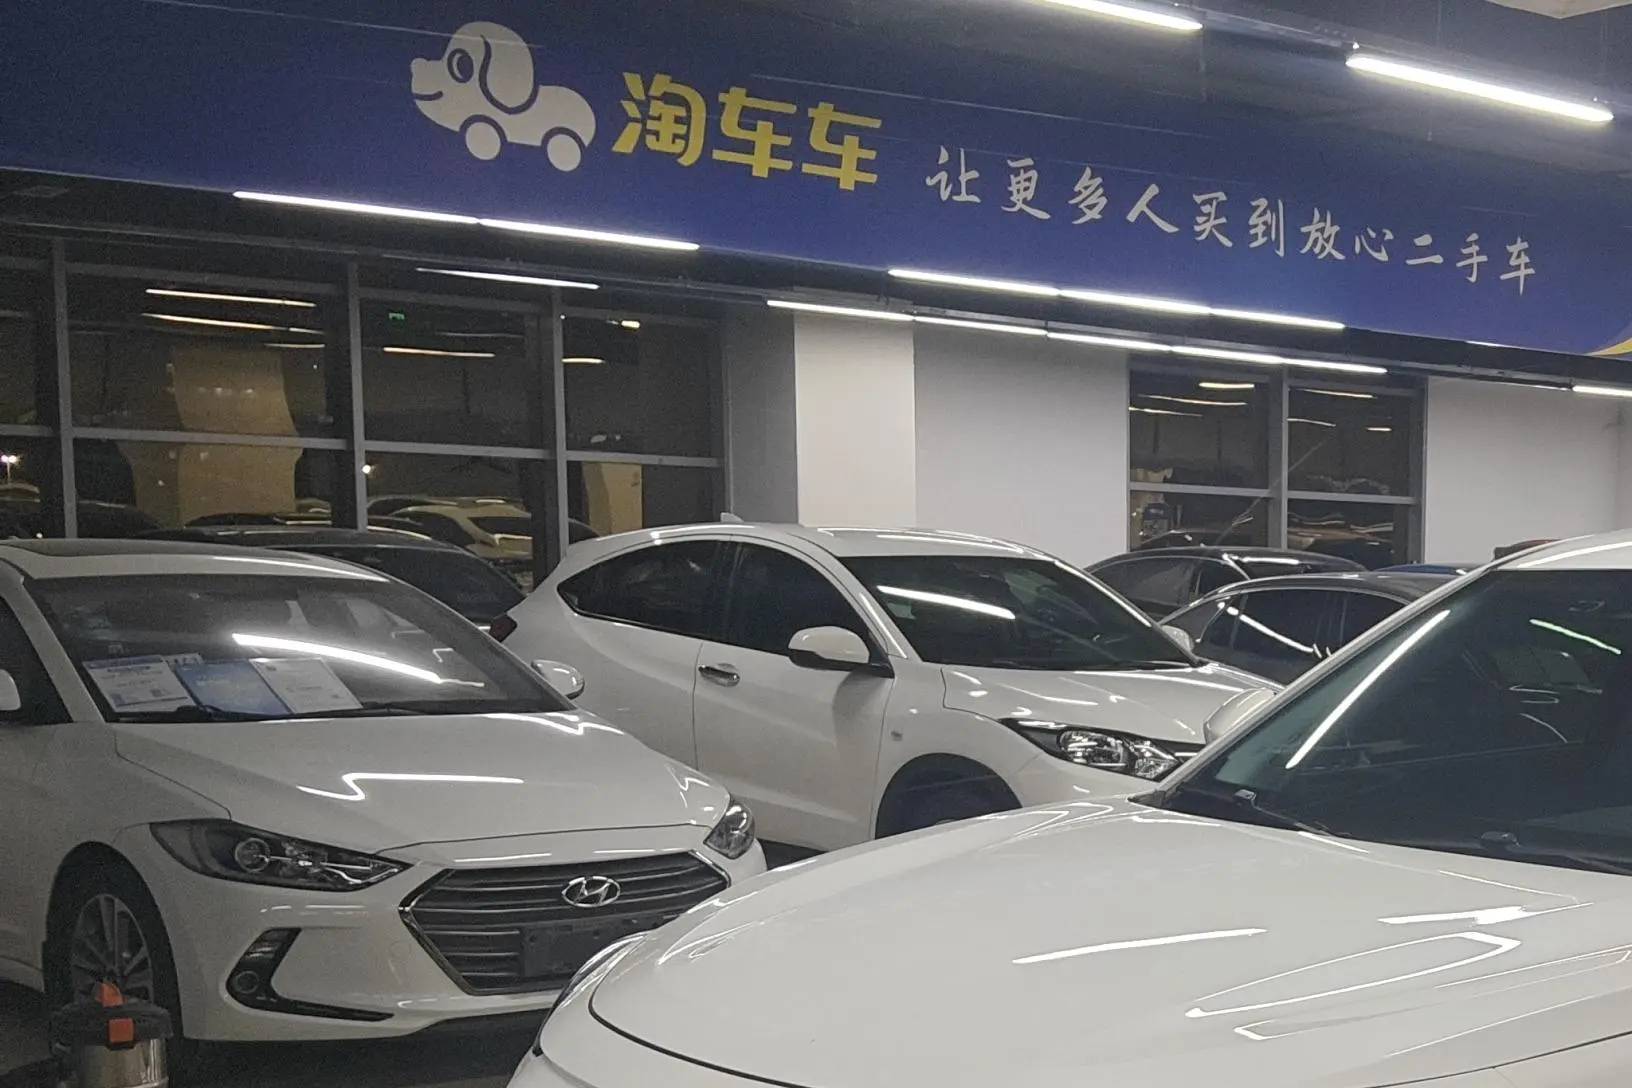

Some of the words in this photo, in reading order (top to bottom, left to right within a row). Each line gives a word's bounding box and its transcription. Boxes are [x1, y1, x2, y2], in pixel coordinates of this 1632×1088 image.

[612, 72, 882, 191] 淘车车
[925, 146, 1536, 295] 让更多人买到放心二手车
